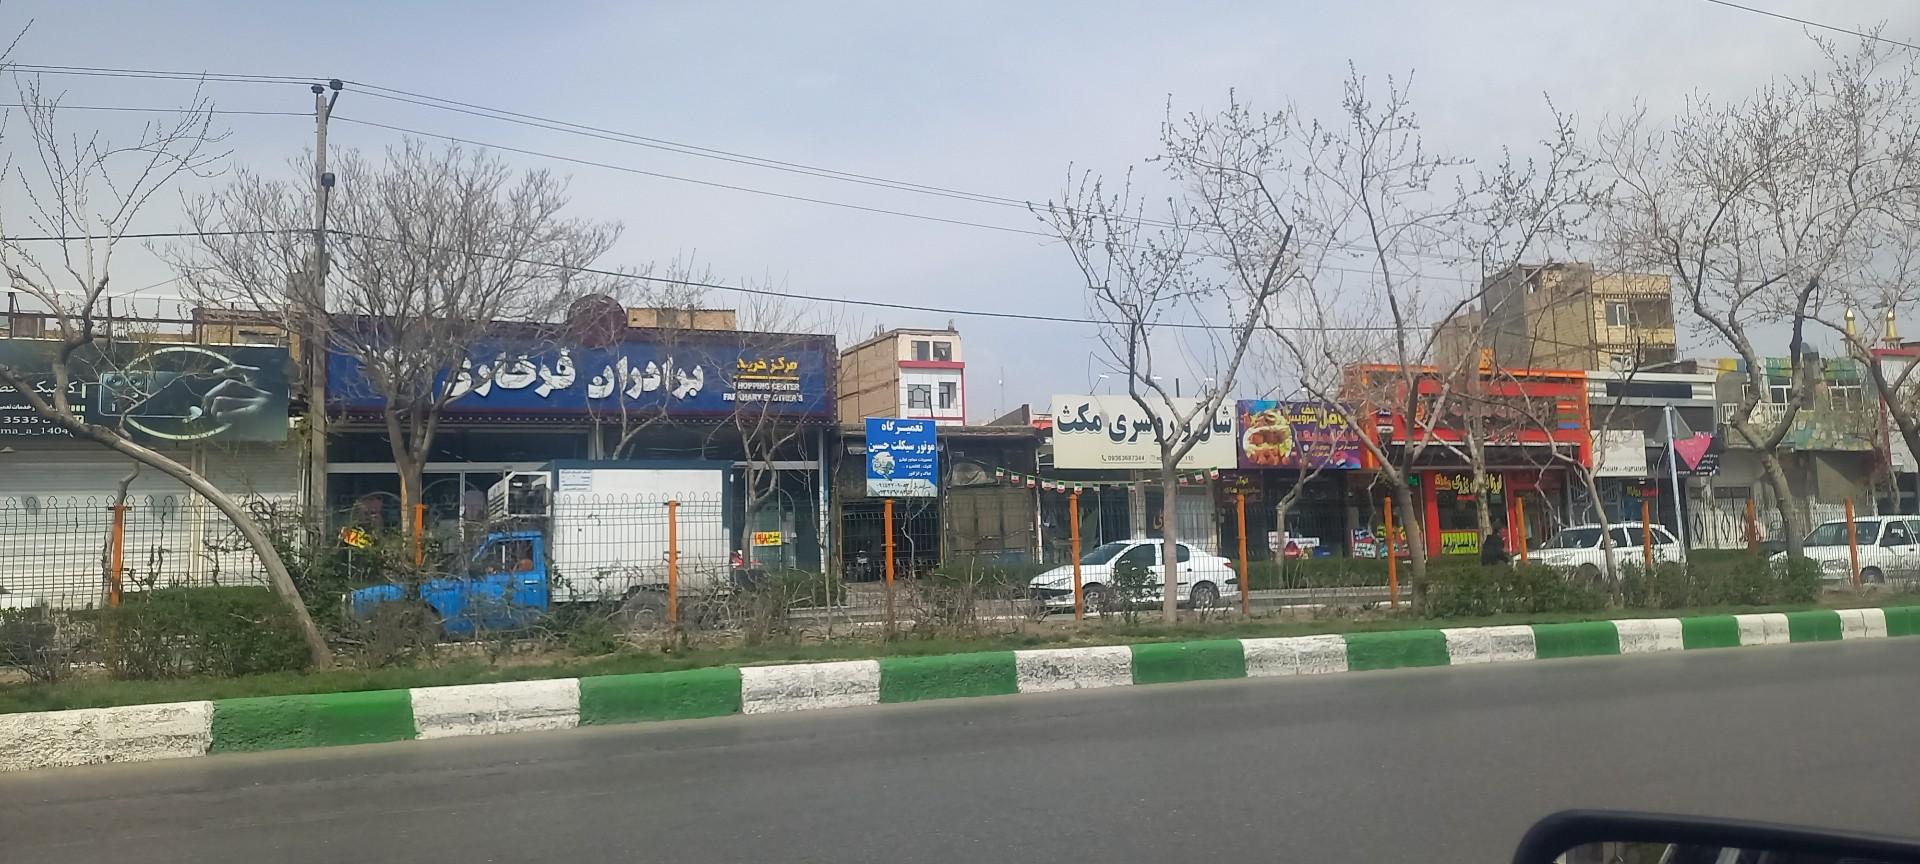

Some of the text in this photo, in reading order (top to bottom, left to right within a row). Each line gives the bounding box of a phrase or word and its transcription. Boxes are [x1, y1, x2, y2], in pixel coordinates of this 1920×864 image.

[588, 353, 705, 400] برادران
[736, 356, 799, 374] مرکز خرید
[1057, 402, 1103, 433] مکث
[868, 439, 936, 454] موتور سیکلت حسین
